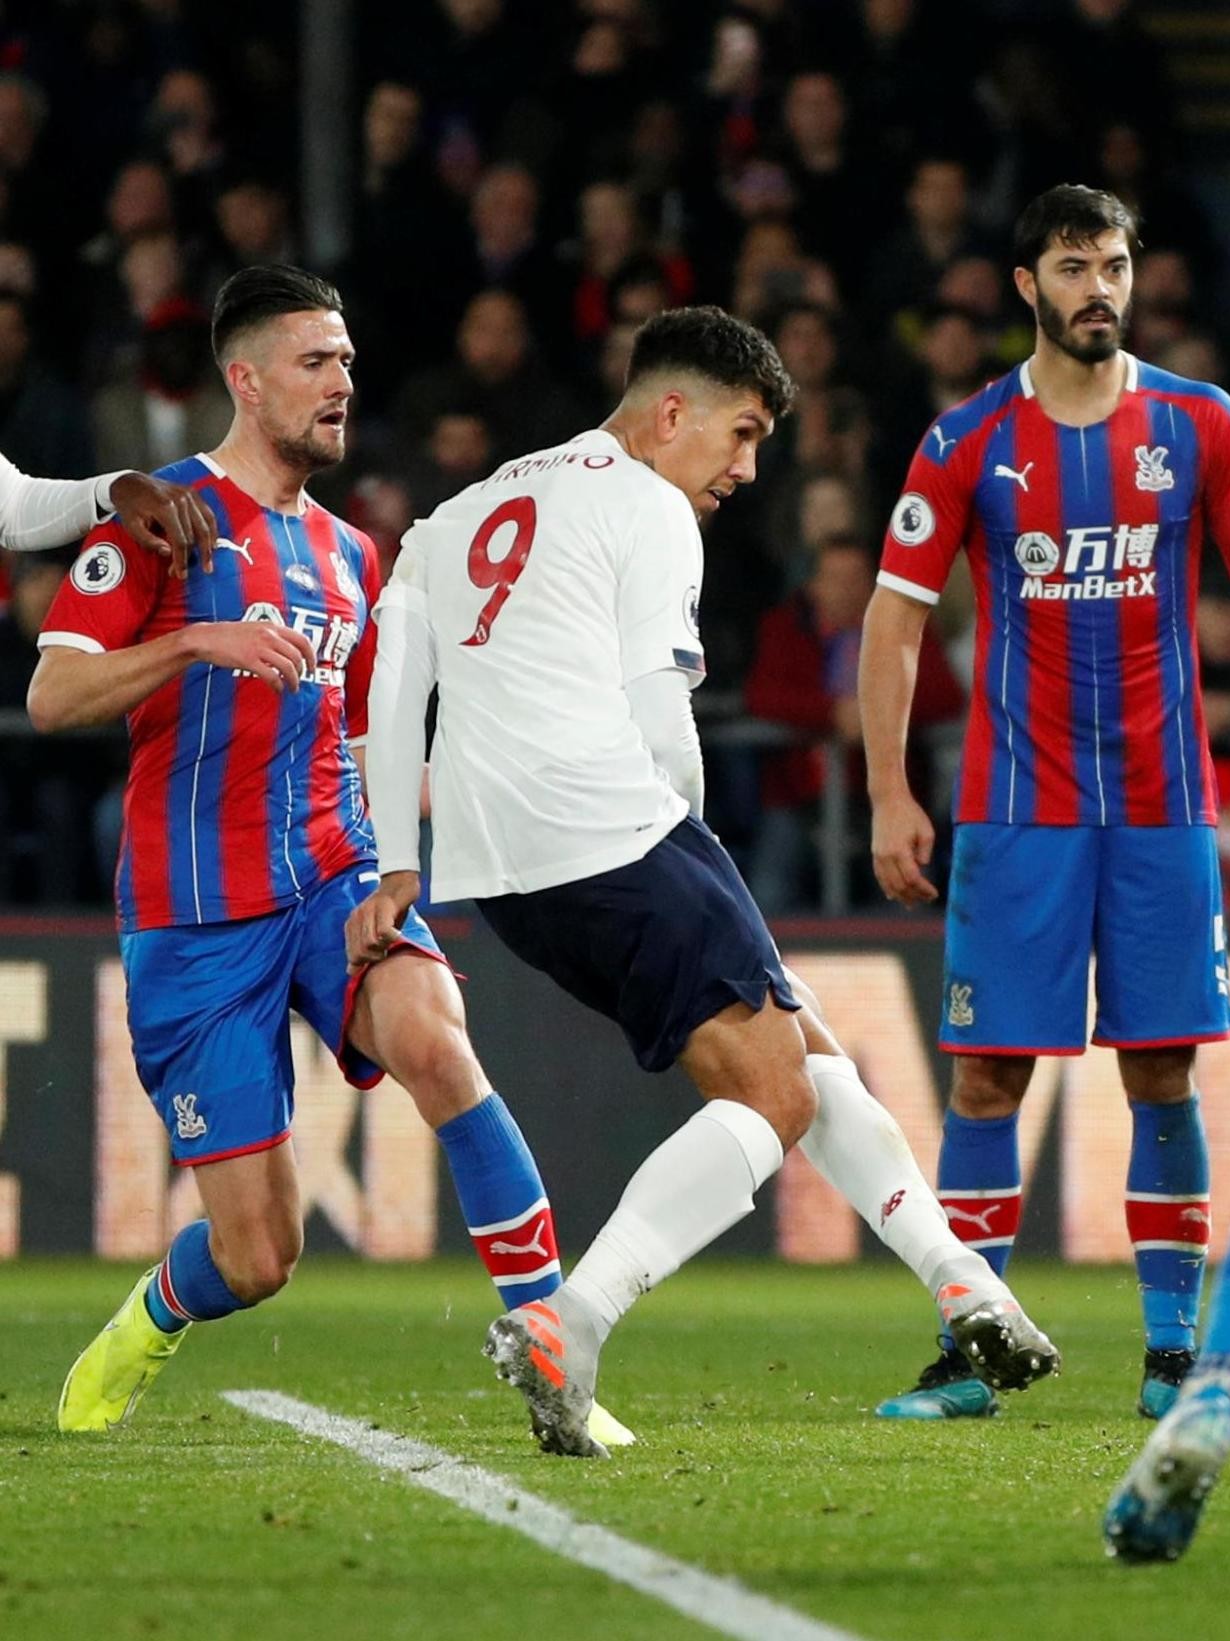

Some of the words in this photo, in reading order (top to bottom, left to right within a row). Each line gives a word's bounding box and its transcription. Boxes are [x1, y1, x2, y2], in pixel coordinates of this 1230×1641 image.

[458, 495, 537, 647] 9
[1063, 523, 1160, 574] 万博
[1019, 571, 1157, 600] ManBetX
